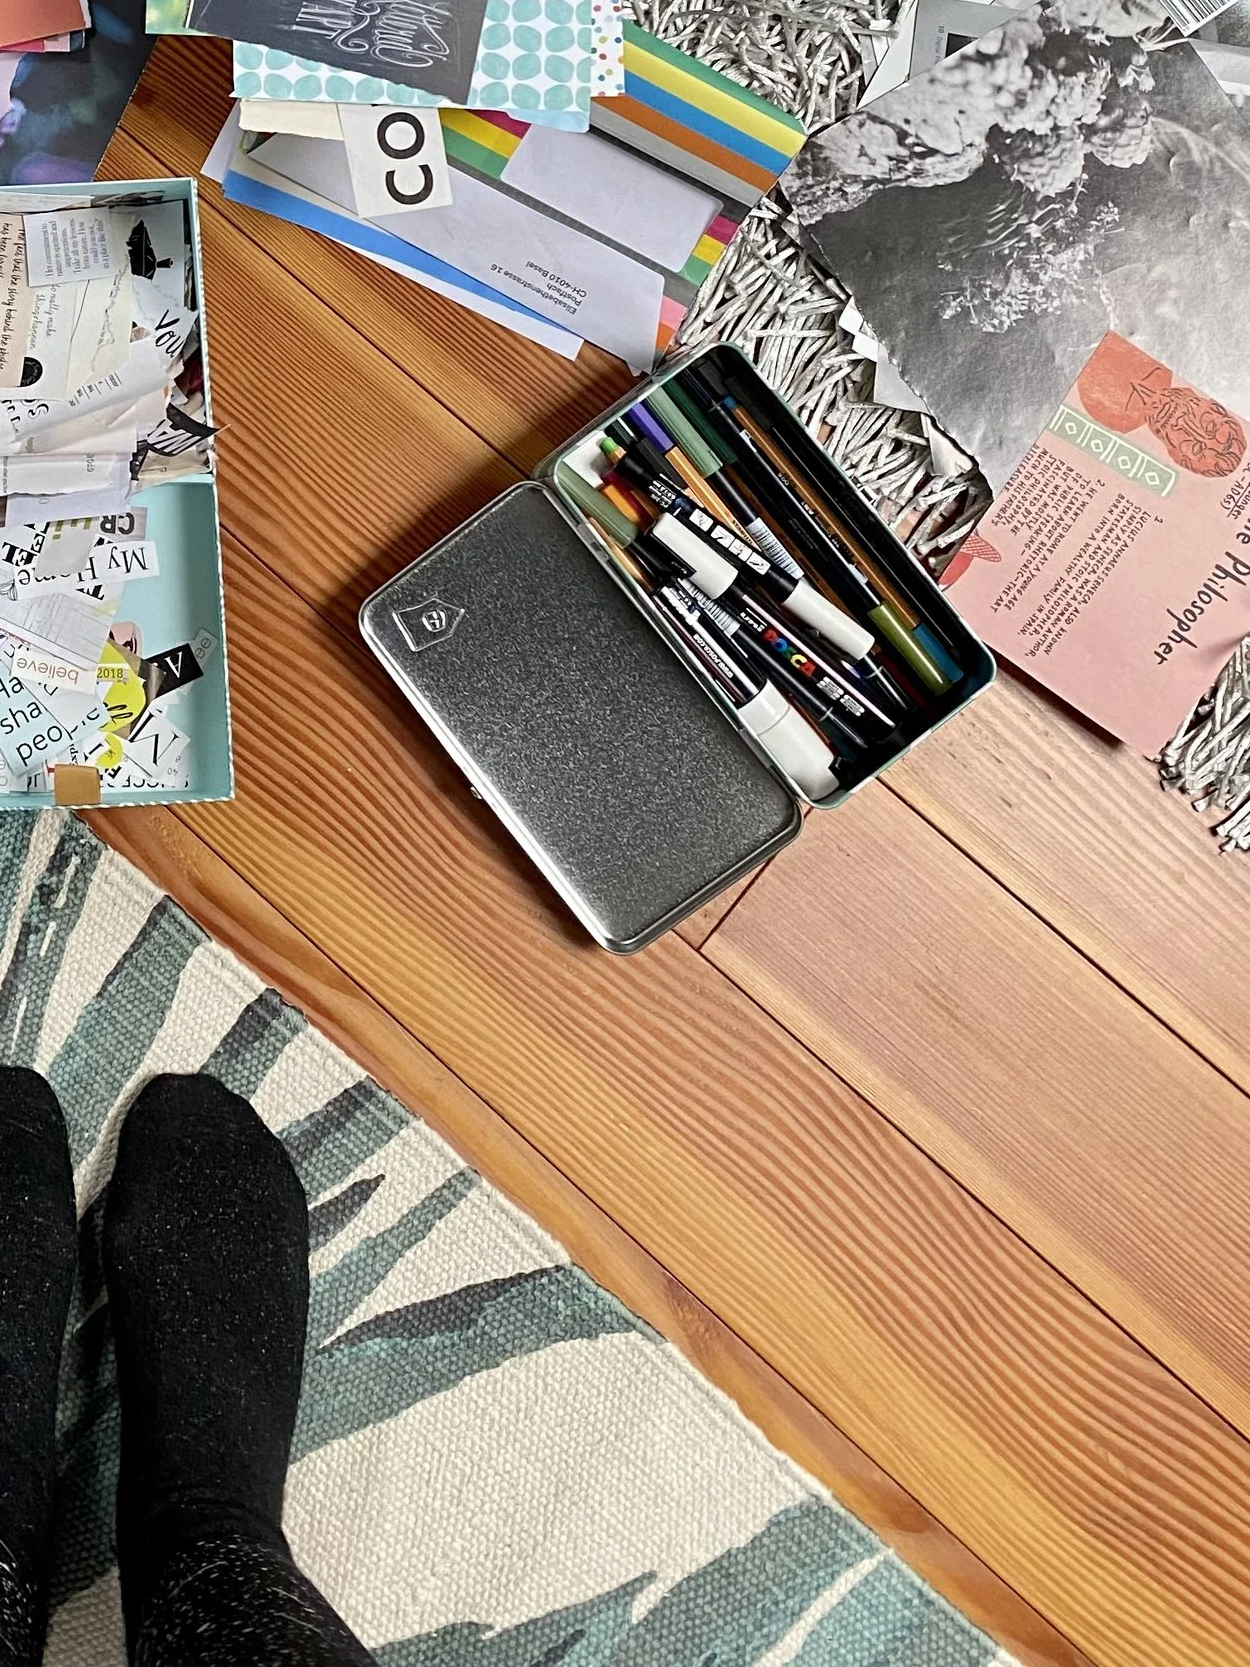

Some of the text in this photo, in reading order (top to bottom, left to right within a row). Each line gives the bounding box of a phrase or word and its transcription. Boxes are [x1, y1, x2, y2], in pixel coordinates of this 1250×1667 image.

[377, 104, 434, 205] CO
[0, 223, 12, 235] has
[0, 236, 10, 252] been
[490, 264, 578, 315] Elisabethenstrasse 16
[525, 261, 587, 298] CH-4010 Basel
[546, 283, 583, 307] Postfach
[0, 274, 20, 346] the story behind the
[154, 308, 183, 363] You
[998, 453, 1058, 528] STOIC PHILOSOPHY,
[1010, 446, 1050, 499] MUCH TO HIS
[1050, 471, 1083, 512] OF PUBLIC
[1009, 458, 1067, 536] FASCINATED BY THE
[1023, 464, 1075, 531] BUT WAS MOSTLY
[987, 476, 1092, 613] TO LEARN ABOUT ART
[1002, 485, 1097, 612] HE WENT TO ROME AT A YOUNG AGE
[1125, 510, 1151, 542] LUCIUS
[107, 546, 149, 575] My
[1016, 492, 1126, 639] BORN INTO A WEALTHY FAMILY IN SPAIN.
[1021, 504, 1142, 663] SIMPLY AS SENECA, WAS A ROMAN AUTHOR,
[1027, 498, 1134, 639] STATESMAN AND STOIC PHILOSOPHER,
[1076, 573, 1104, 608] SENECA,
[1153, 552, 1250, 666] Philosopher
[1063, 606, 1081, 627] ALSO
[762, 629, 816, 677] POSCA
[1042, 626, 1067, 656] KNOWN
[16, 656, 79, 684] believe
[96, 667, 124, 679] 2018
[0, 701, 43, 735] sha
[15, 725, 64, 767] peo
